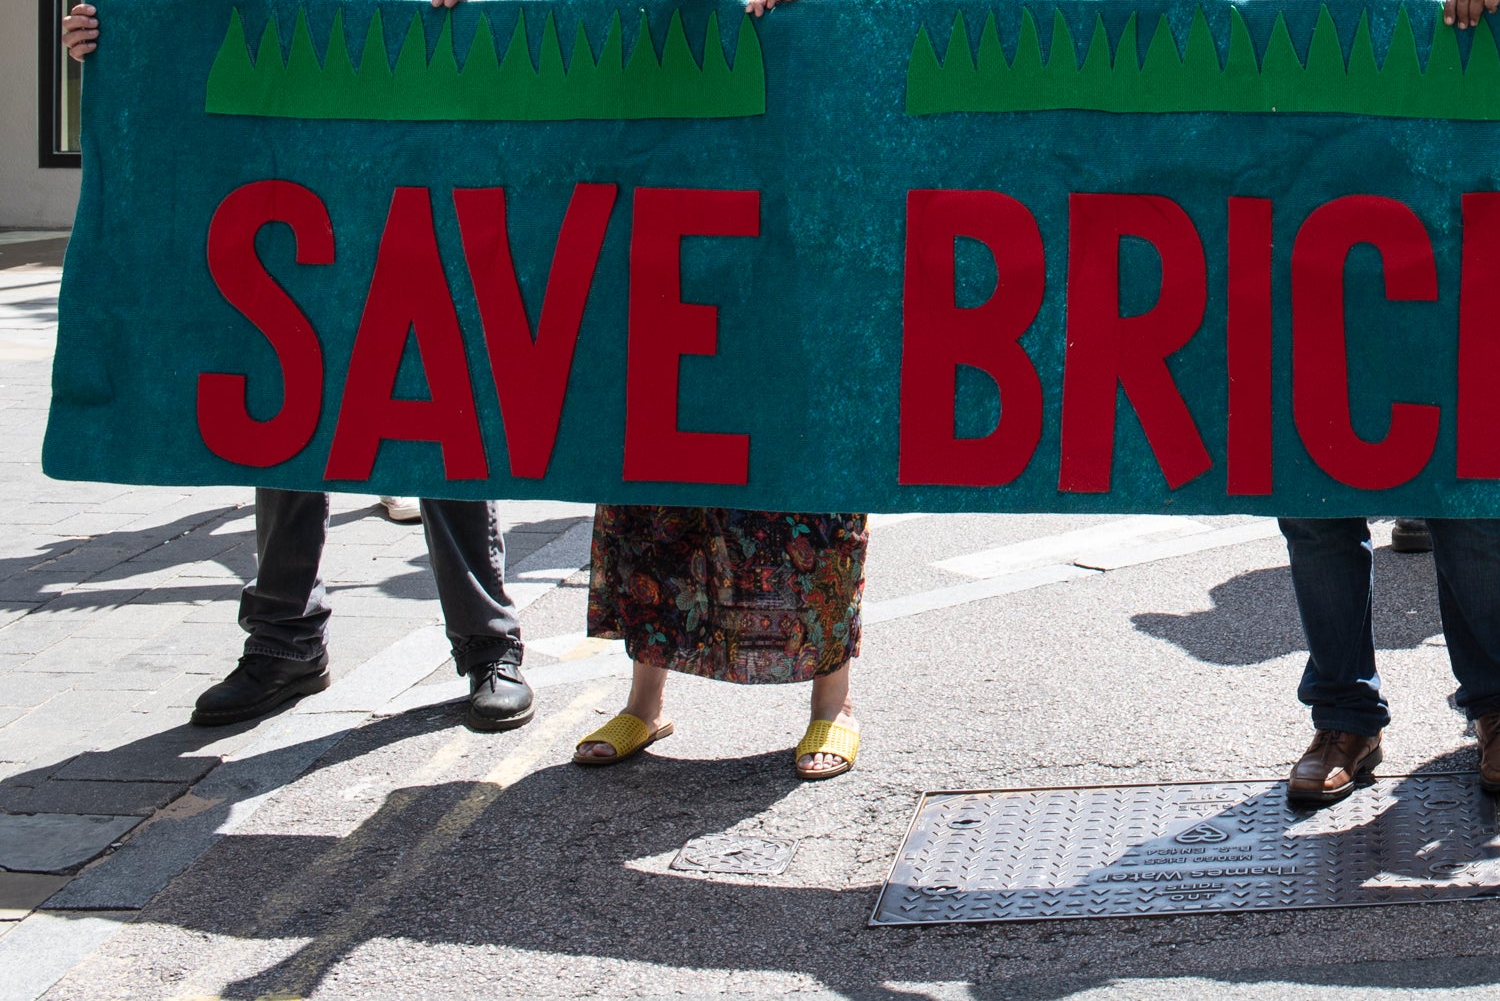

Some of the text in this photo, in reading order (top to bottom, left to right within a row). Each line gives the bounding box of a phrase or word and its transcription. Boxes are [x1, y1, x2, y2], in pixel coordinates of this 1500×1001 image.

[197, 179, 762, 486] SAVE
[1097, 865, 1303, 884] Thames Water
[1165, 882, 1224, 891] SLIDE
[1170, 893, 1215, 902] OUT
